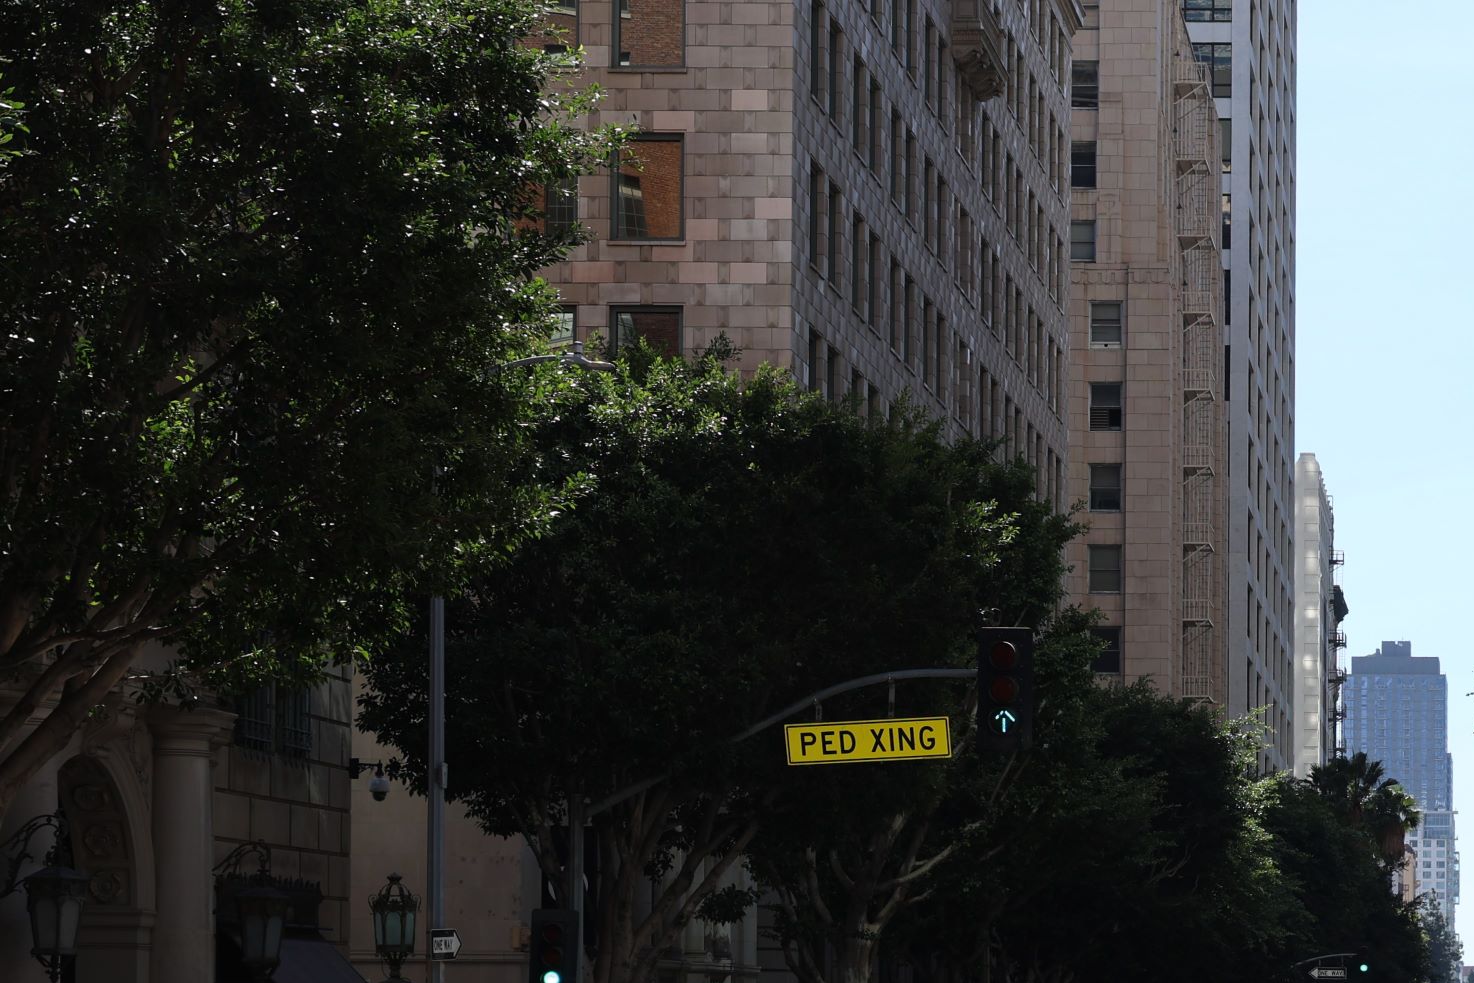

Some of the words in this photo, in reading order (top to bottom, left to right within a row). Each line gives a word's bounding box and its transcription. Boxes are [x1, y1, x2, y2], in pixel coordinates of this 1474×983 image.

[801, 731, 856, 756] PED
[871, 726, 936, 752] XING
[434, 939, 444, 951] ONE
[445, 939, 454, 951] WAY
